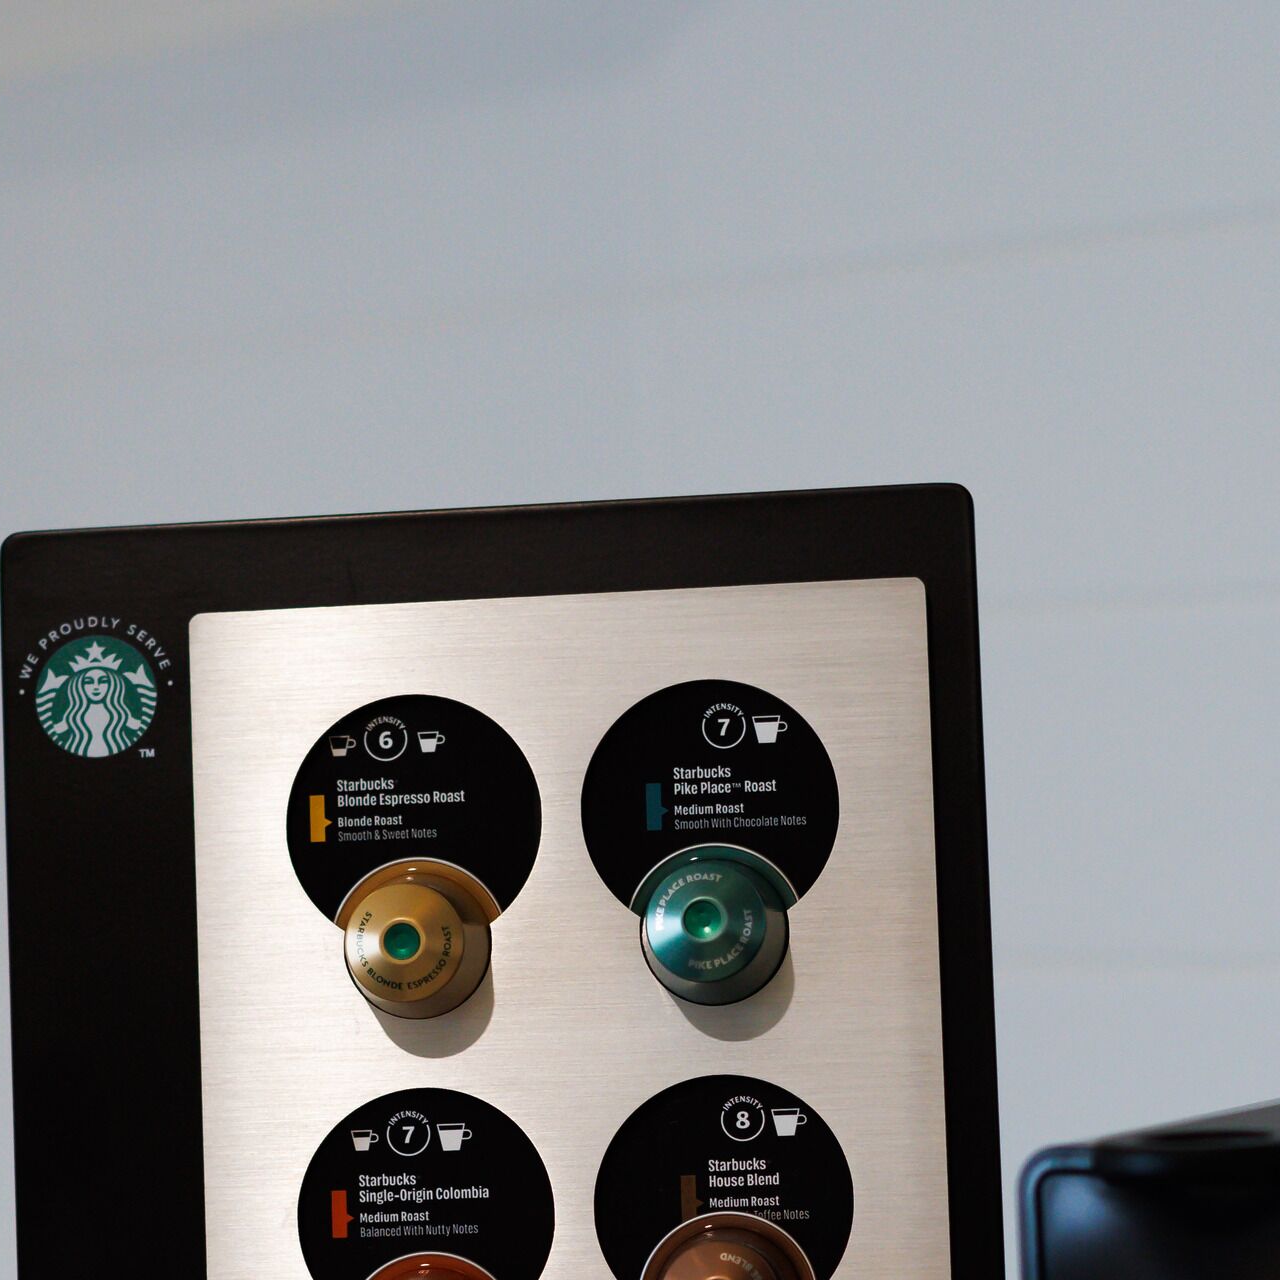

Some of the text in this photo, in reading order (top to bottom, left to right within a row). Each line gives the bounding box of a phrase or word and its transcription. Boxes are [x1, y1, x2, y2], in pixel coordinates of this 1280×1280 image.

[19, 617, 171, 679] WE PROUDLY SERVE
[704, 703, 744, 718] INTENSITY
[366, 716, 407, 731] INTENSITY
[718, 719, 730, 736] 7
[379, 731, 393, 749] 6
[673, 766, 731, 780] Starbucks
[337, 778, 394, 792] Starbucks
[674, 782, 697, 795] Pike
[745, 780, 776, 792] Roast
[337, 790, 465, 807] Blonde Espresso Roast
[674, 804, 744, 816] Medium Roast
[338, 816, 402, 827] Blonde Roast
[675, 816, 806, 830] Smooth With Chocolate Notes
[338, 828, 437, 842] Smooth & Sweet Notes
[659, 879, 685, 906] PLACE
[687, 873, 722, 883] ROAST
[688, 909, 753, 970] PIKE PLACE ROAST
[356, 911, 451, 990] STARBUCKS BLONDE ESPRESSO ROAST
[723, 1095, 764, 1111] INTENSITY
[389, 1110, 429, 1126] INTENSITY
[736, 1111, 750, 1129] 8
[402, 1126, 415, 1144] 7
[708, 1158, 766, 1172] Starbucks
[359, 1173, 416, 1187] Starbucks
[709, 1172, 779, 1188] House Blend
[359, 1186, 489, 1205] Single-Origin Colombia
[710, 1196, 779, 1209] Medium Roast
[360, 1211, 429, 1223] Medium Roast
[784, 1209, 809, 1220] Notes
[360, 1224, 478, 1238] Balanced With Nutty Notes
[720, 1252, 753, 1271] BLEND
